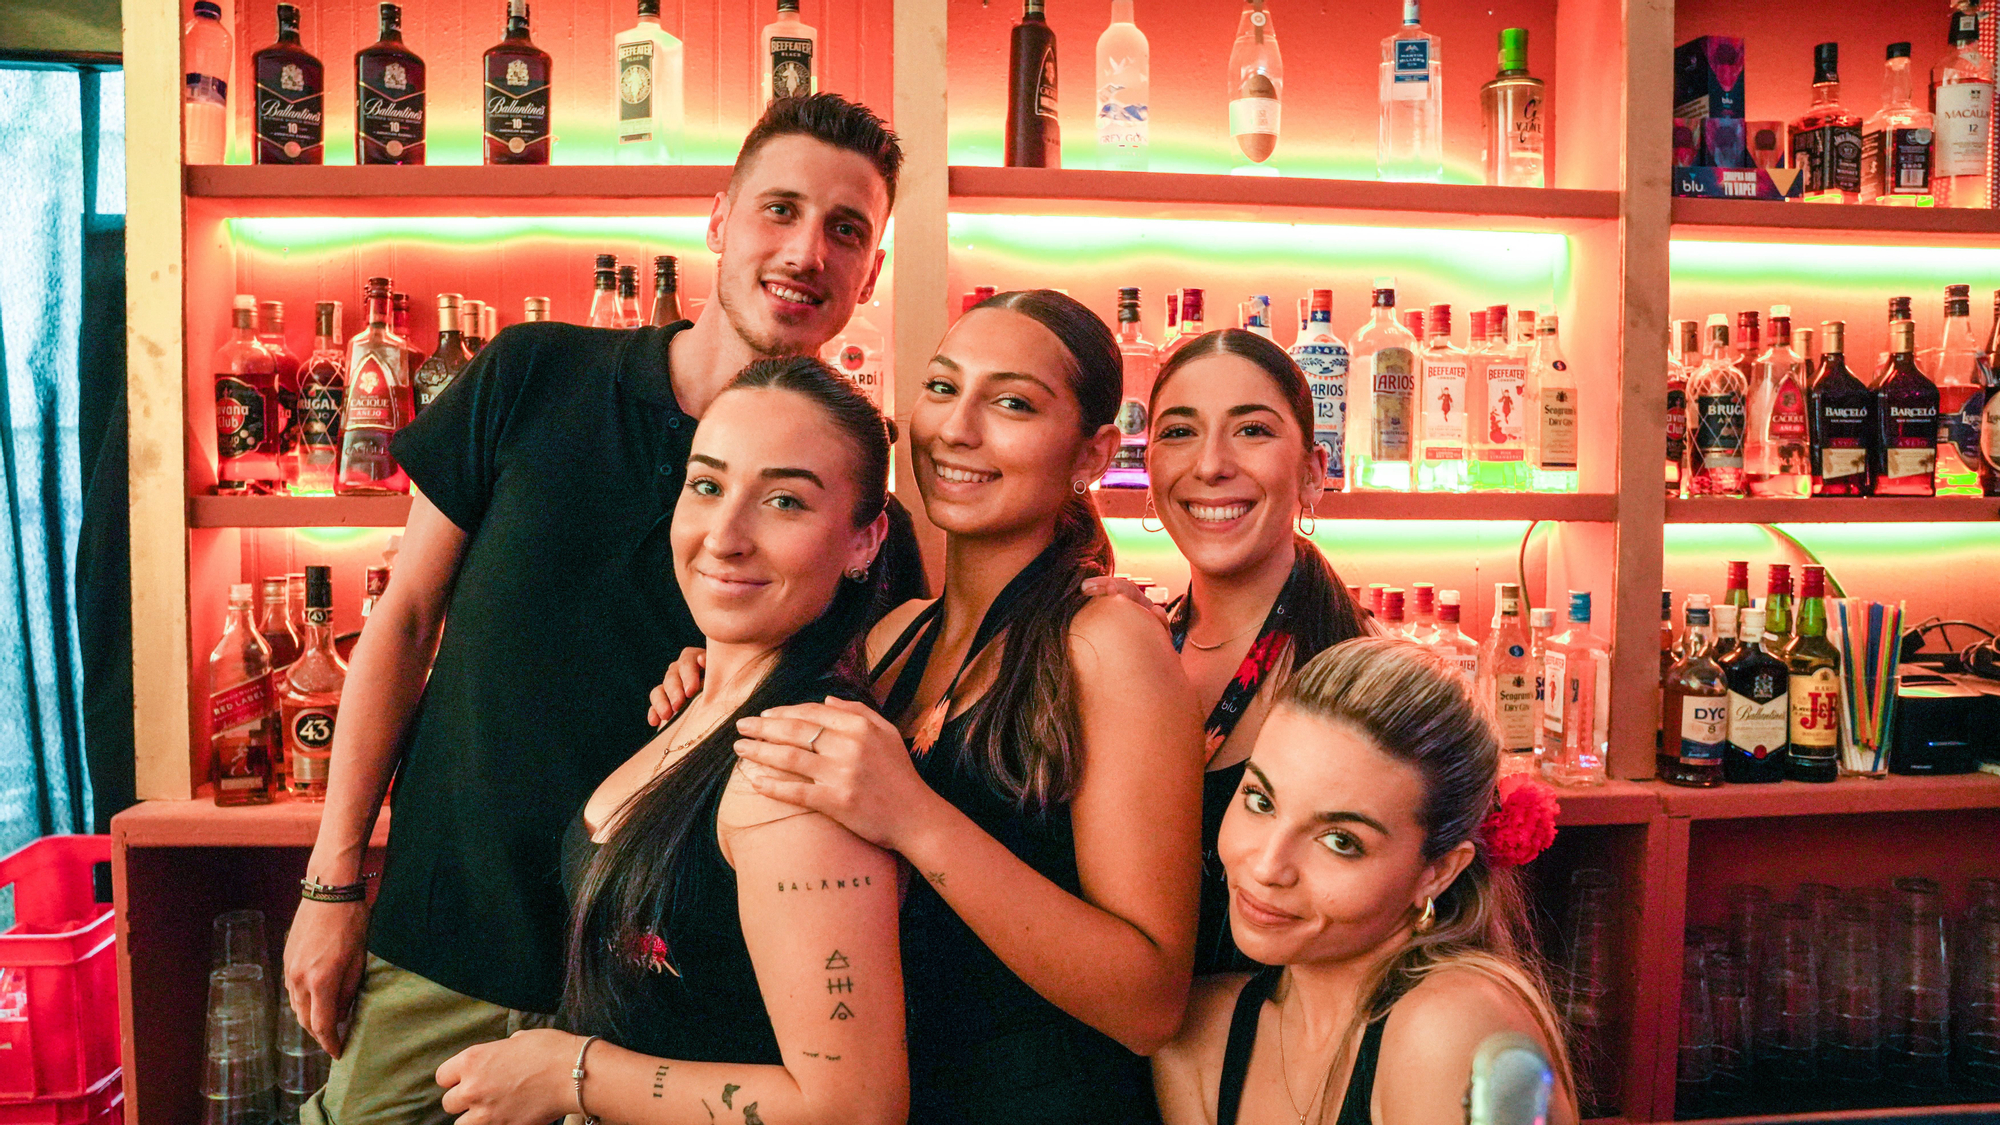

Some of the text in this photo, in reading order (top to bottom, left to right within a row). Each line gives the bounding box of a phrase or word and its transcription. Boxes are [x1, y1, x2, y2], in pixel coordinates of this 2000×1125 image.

[619, 44, 652, 60] BEEFEATER
[771, 41, 812, 55] BEEFEATER
[261, 98, 321, 122] Ballantine's
[363, 97, 423, 120] Ballantine's
[487, 96, 546, 115] Ballantine's
[287, 122, 298, 134] 10
[389, 121, 400, 133] 10
[512, 118, 522, 129] 10
[1969, 123, 1979, 133] 12
[1682, 179, 1704, 192] blu
[1428, 366, 1466, 379] BEEFEATER
[1488, 368, 1525, 381] BEEFEATER
[1311, 383, 1344, 396] ARIOS
[1373, 374, 1414, 392] LARIOS
[350, 398, 389, 408] CACIQUE
[1318, 401, 1334, 418] 12
[1825, 406, 1868, 418] BARCELÓ
[1890, 406, 1936, 418] BARCELÓ
[311, 612, 323, 621] 43
[213, 690, 265, 715] RED LABEL
[1221, 700, 1238, 713] blu
[1694, 707, 1726, 720] DYC
[299, 719, 331, 741] 43
[1707, 724, 1716, 734] 8
[778, 876, 872, 892] BALANCE
